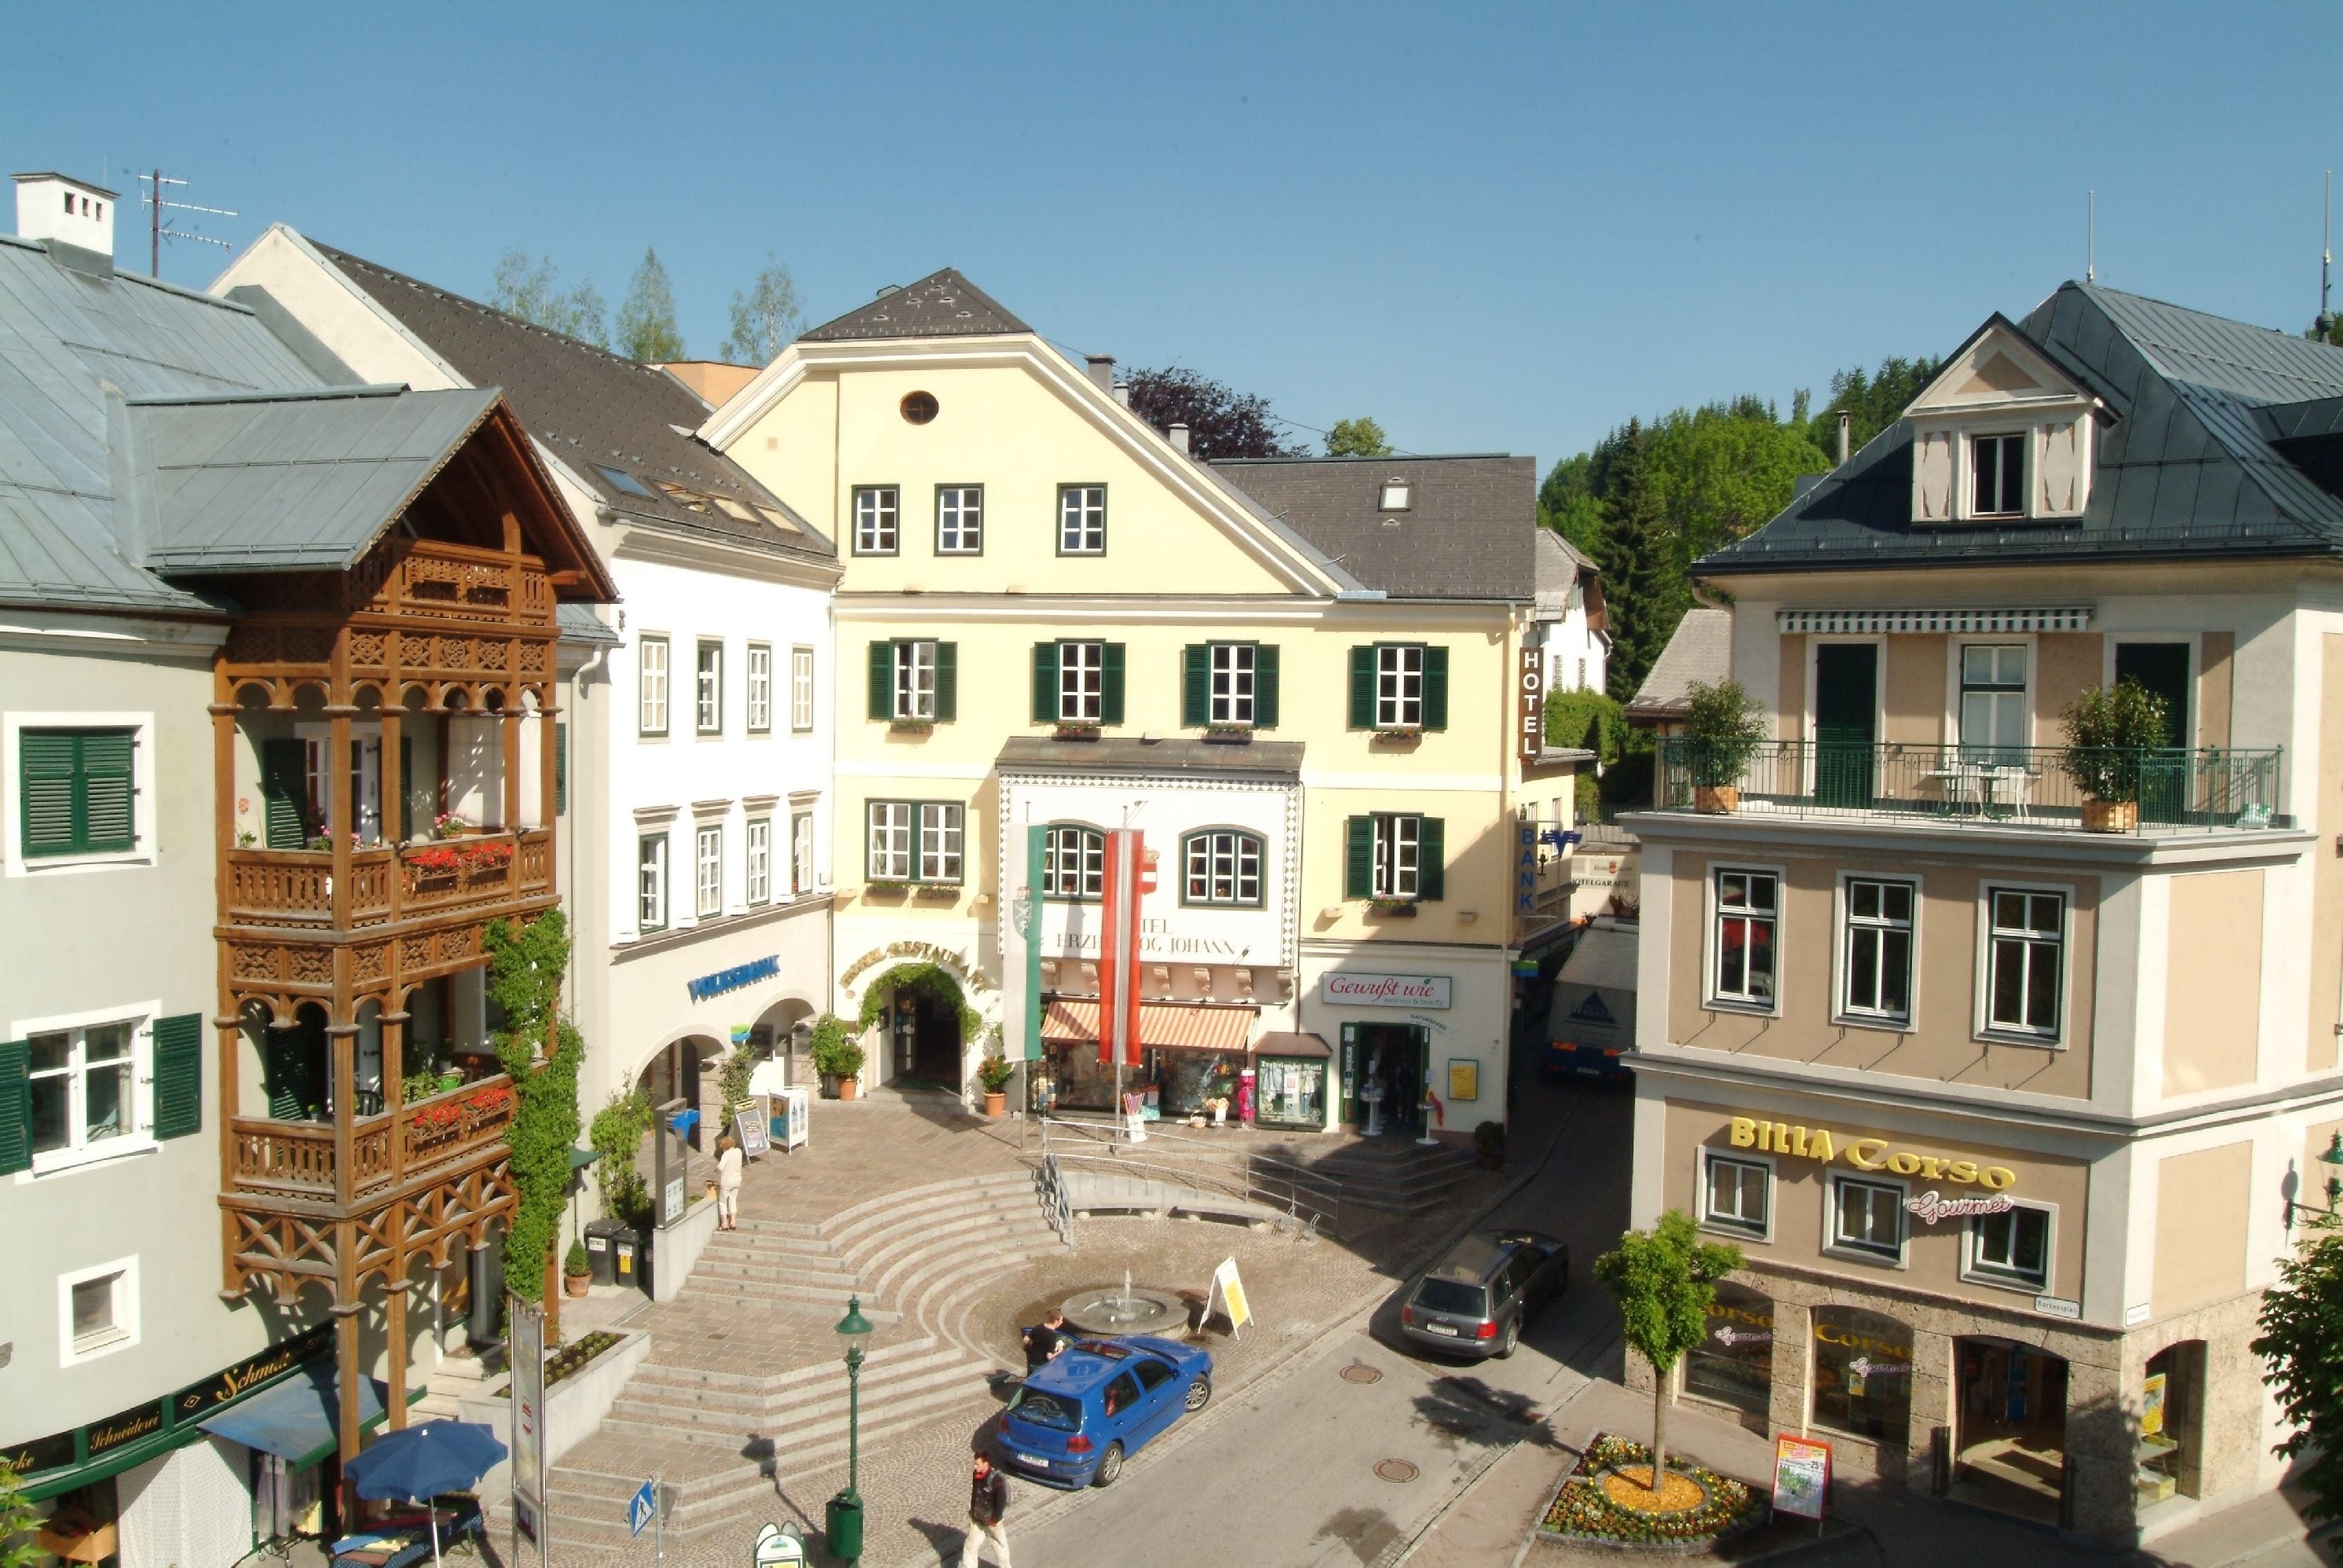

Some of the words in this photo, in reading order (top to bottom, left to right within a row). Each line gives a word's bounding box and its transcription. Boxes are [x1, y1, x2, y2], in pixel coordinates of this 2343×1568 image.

[1523, 652, 1540, 755] HOTEL
[1520, 830, 1535, 910] BANK
[1140, 918, 1173, 934] TEL
[1170, 938, 1236, 955] JOHANN
[1402, 982, 1435, 997] wie
[1730, 1117, 1834, 1163] BILLA
[1845, 1139, 2016, 1189] Corso
[1908, 1190, 2014, 1224] Gourmet
[1706, 1304, 1774, 1327] orso
[1815, 1323, 1914, 1358] Corso
[214, 1352, 292, 1401] Schmidt
[90, 1412, 160, 1450] Schneiderei
